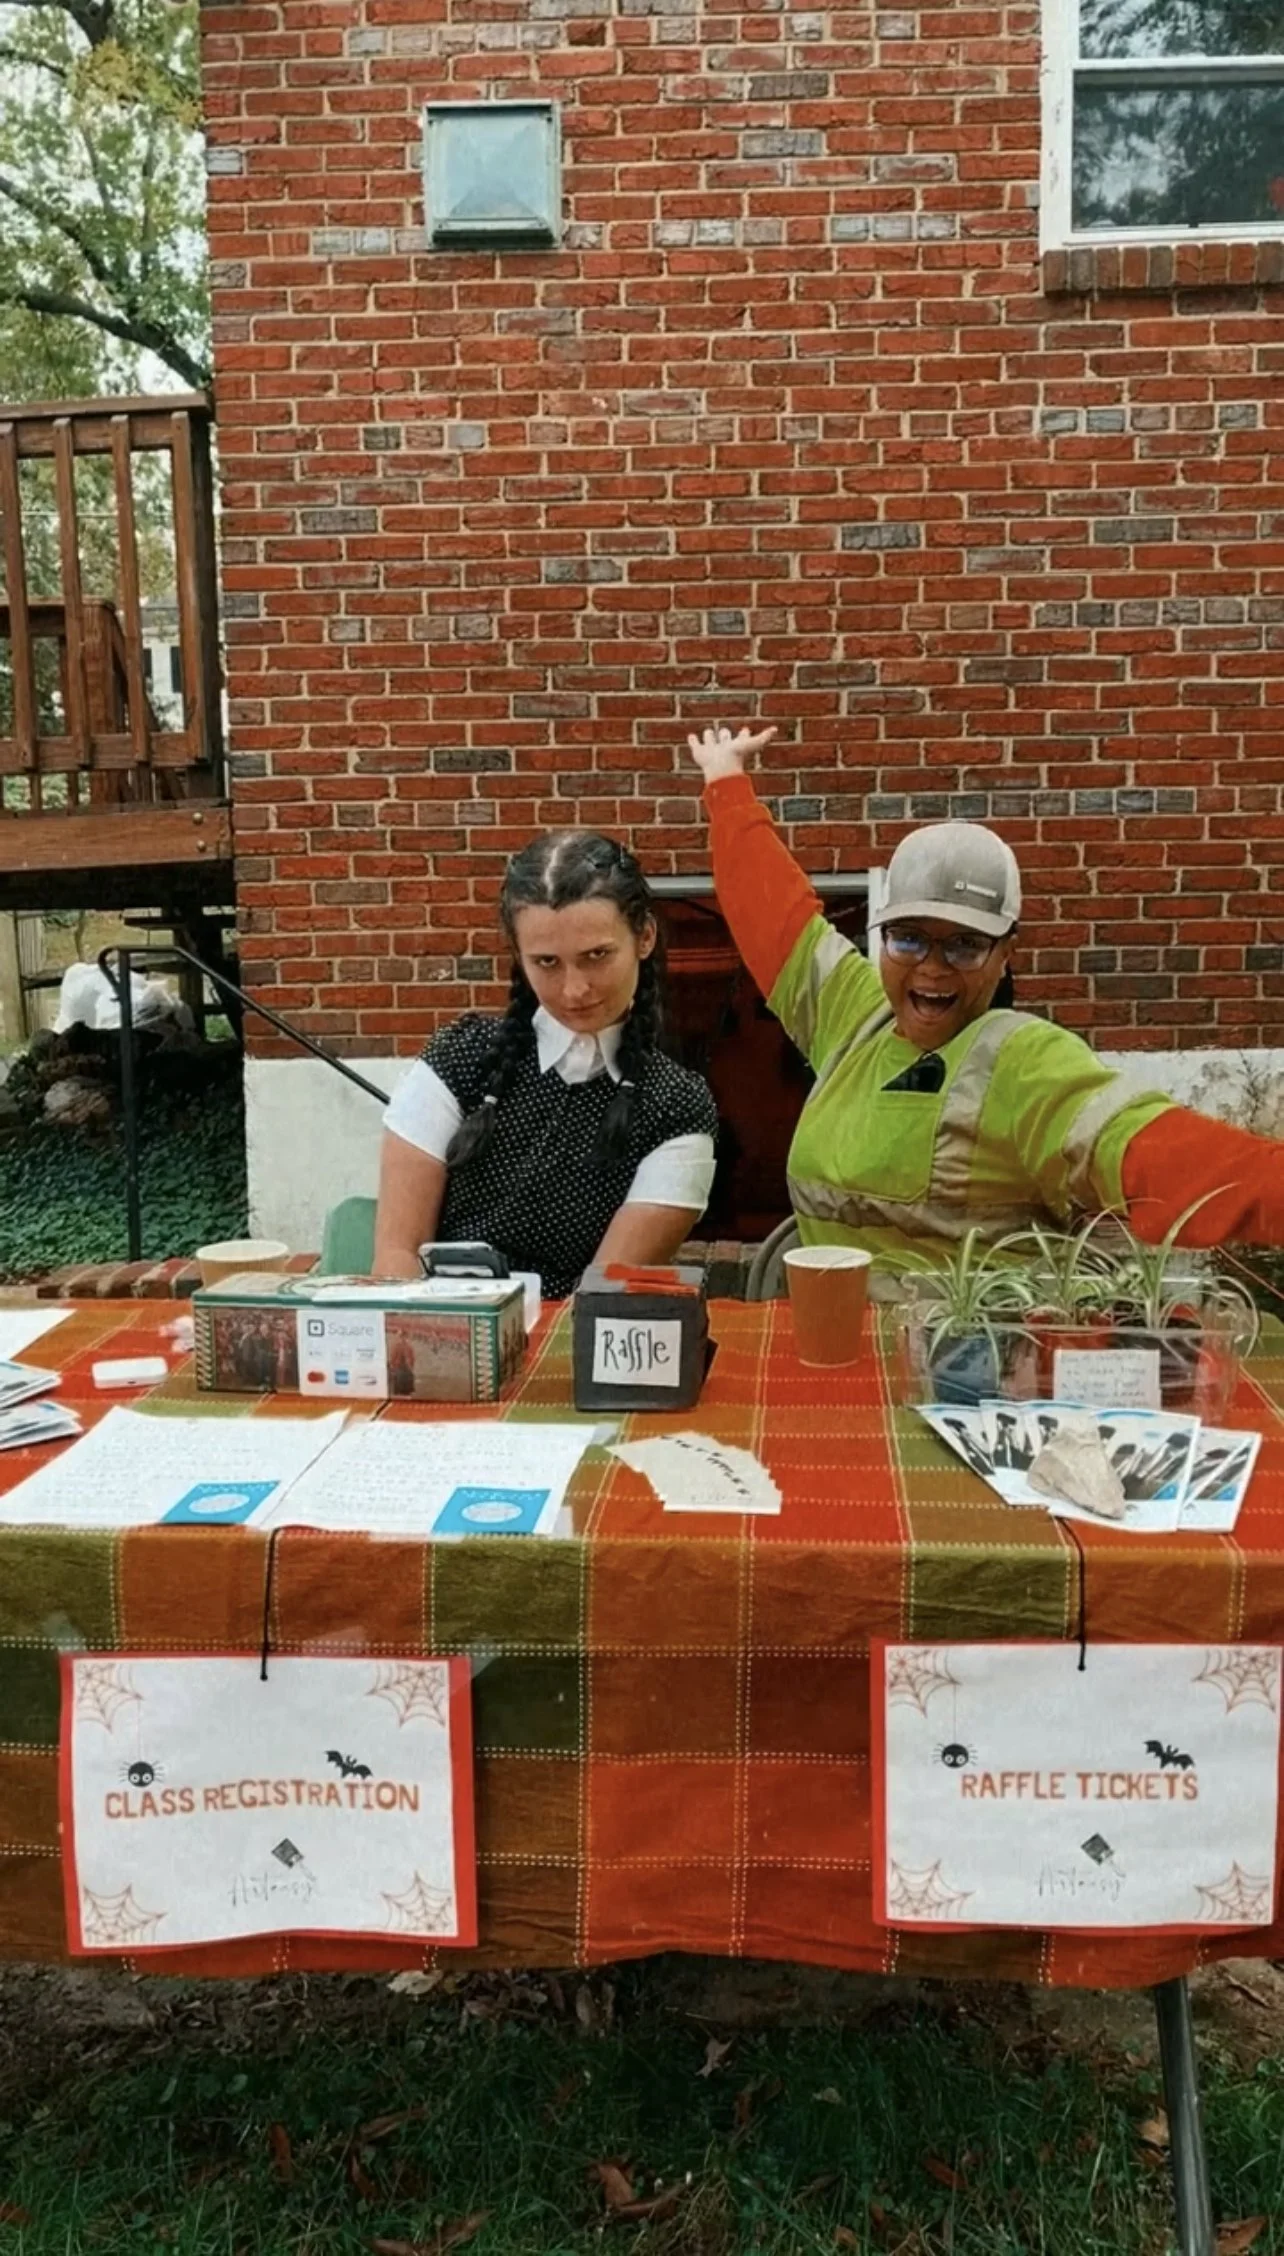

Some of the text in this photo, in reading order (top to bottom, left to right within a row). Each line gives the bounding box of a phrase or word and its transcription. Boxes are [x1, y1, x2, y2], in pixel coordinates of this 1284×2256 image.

[328, 1322, 375, 1337] Square
[601, 1327, 671, 1373] Raffle
[104, 1779, 421, 1819] CLASS REGISTRATION
[960, 1771, 1199, 1801] RAFFLE TICKETS
